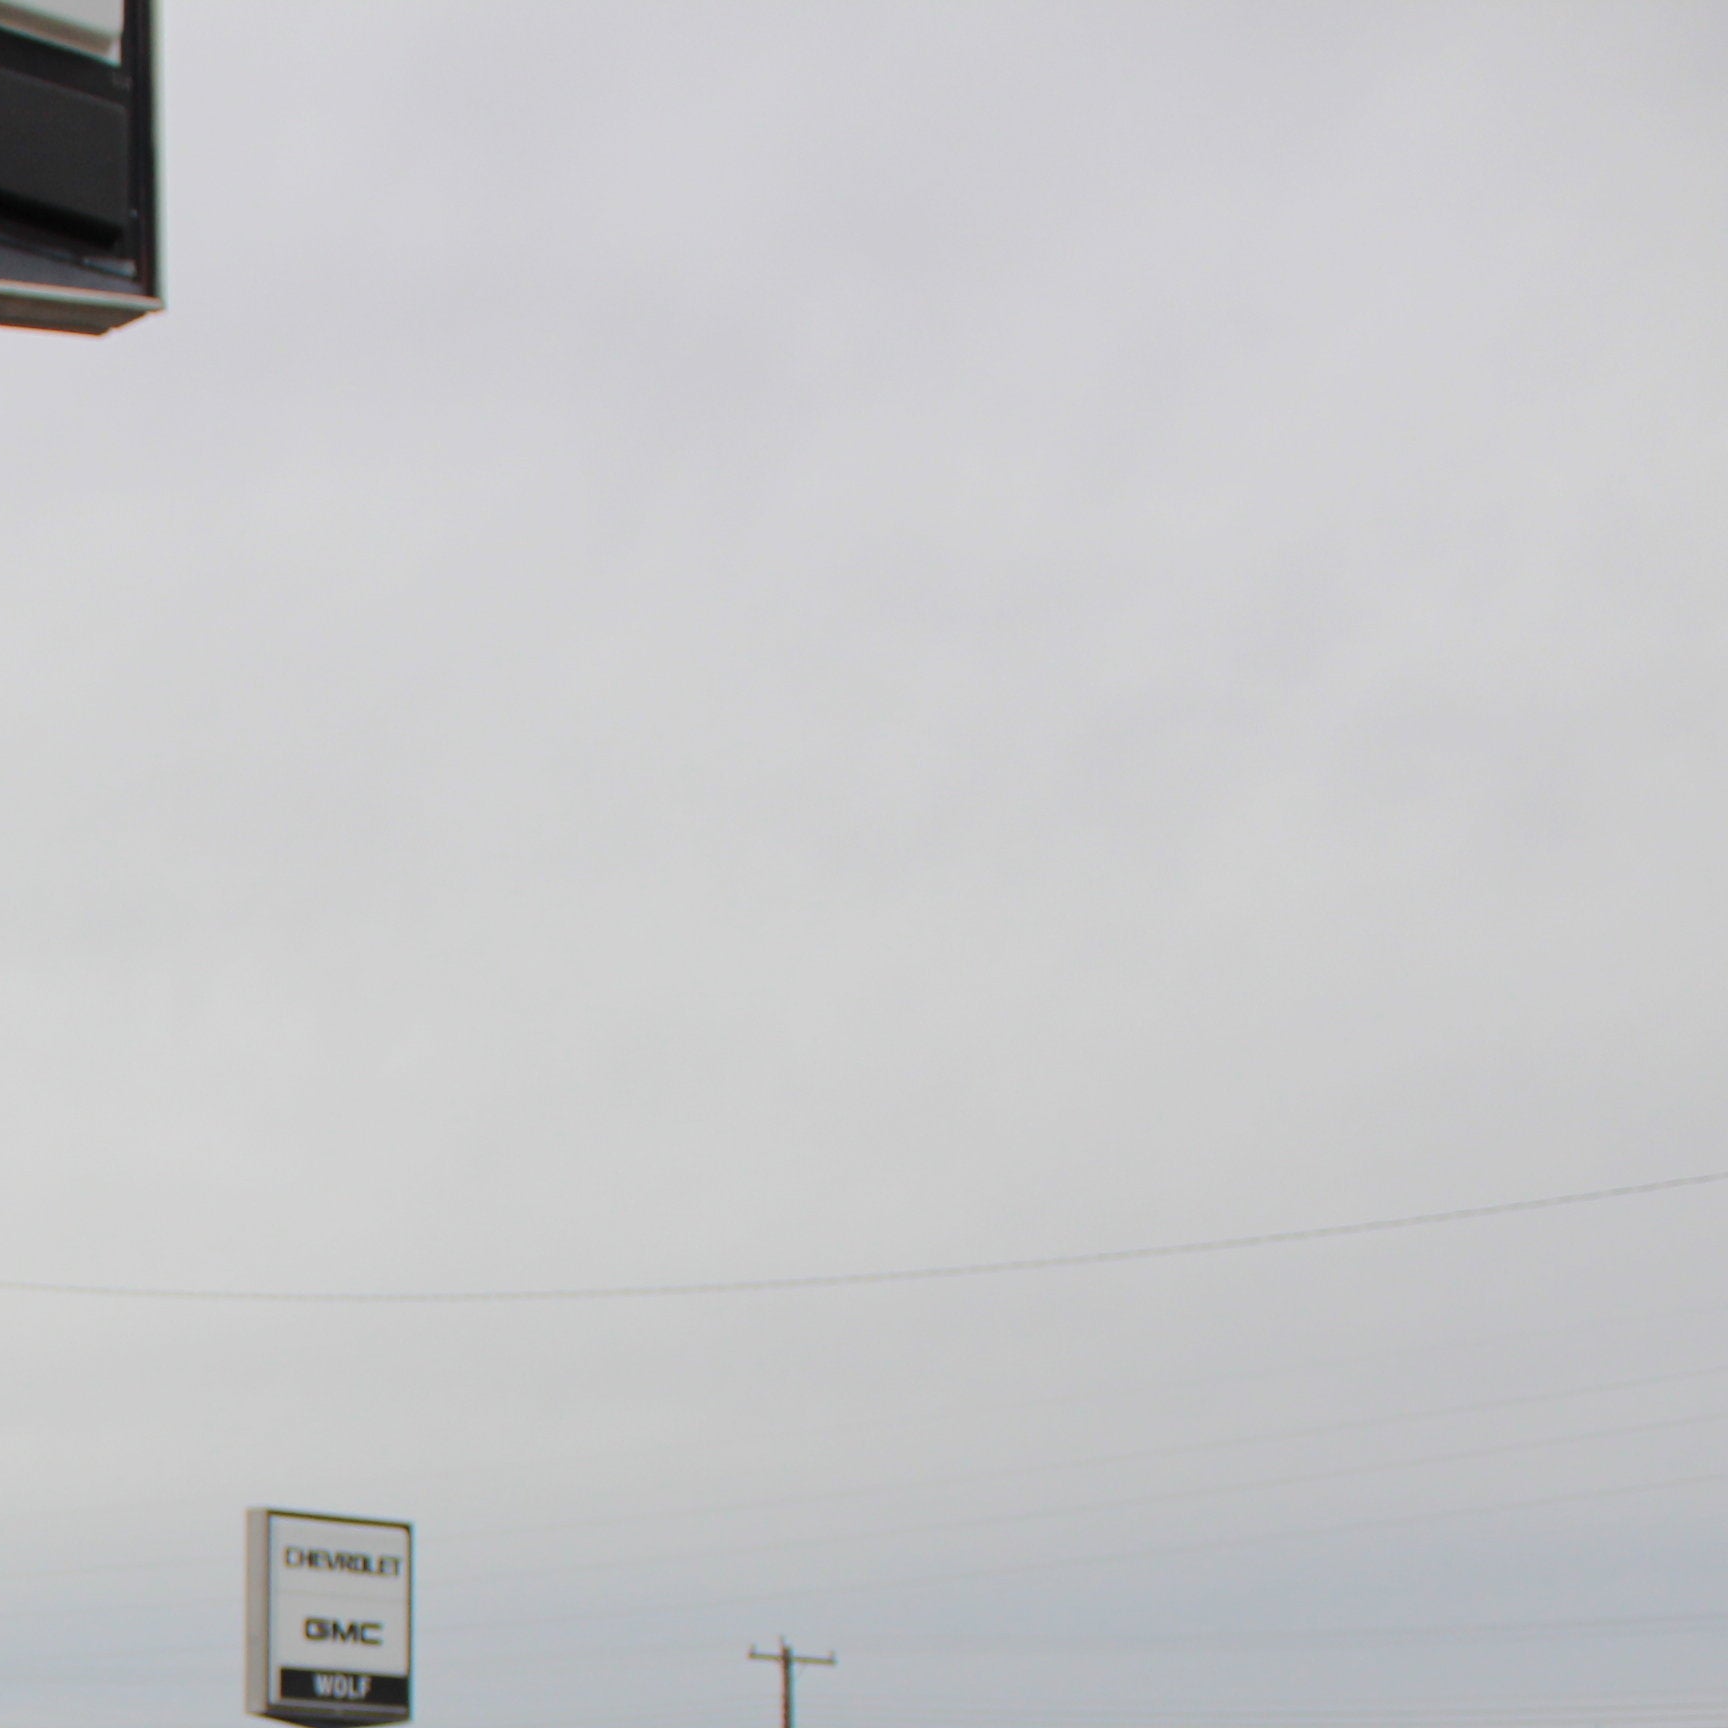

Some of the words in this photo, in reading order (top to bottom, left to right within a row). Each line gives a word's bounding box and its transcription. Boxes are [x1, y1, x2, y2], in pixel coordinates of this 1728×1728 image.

[284, 1546, 402, 1577] CHEVROLET
[303, 1617, 383, 1646] GMC
[314, 1674, 371, 1698] WOLF
